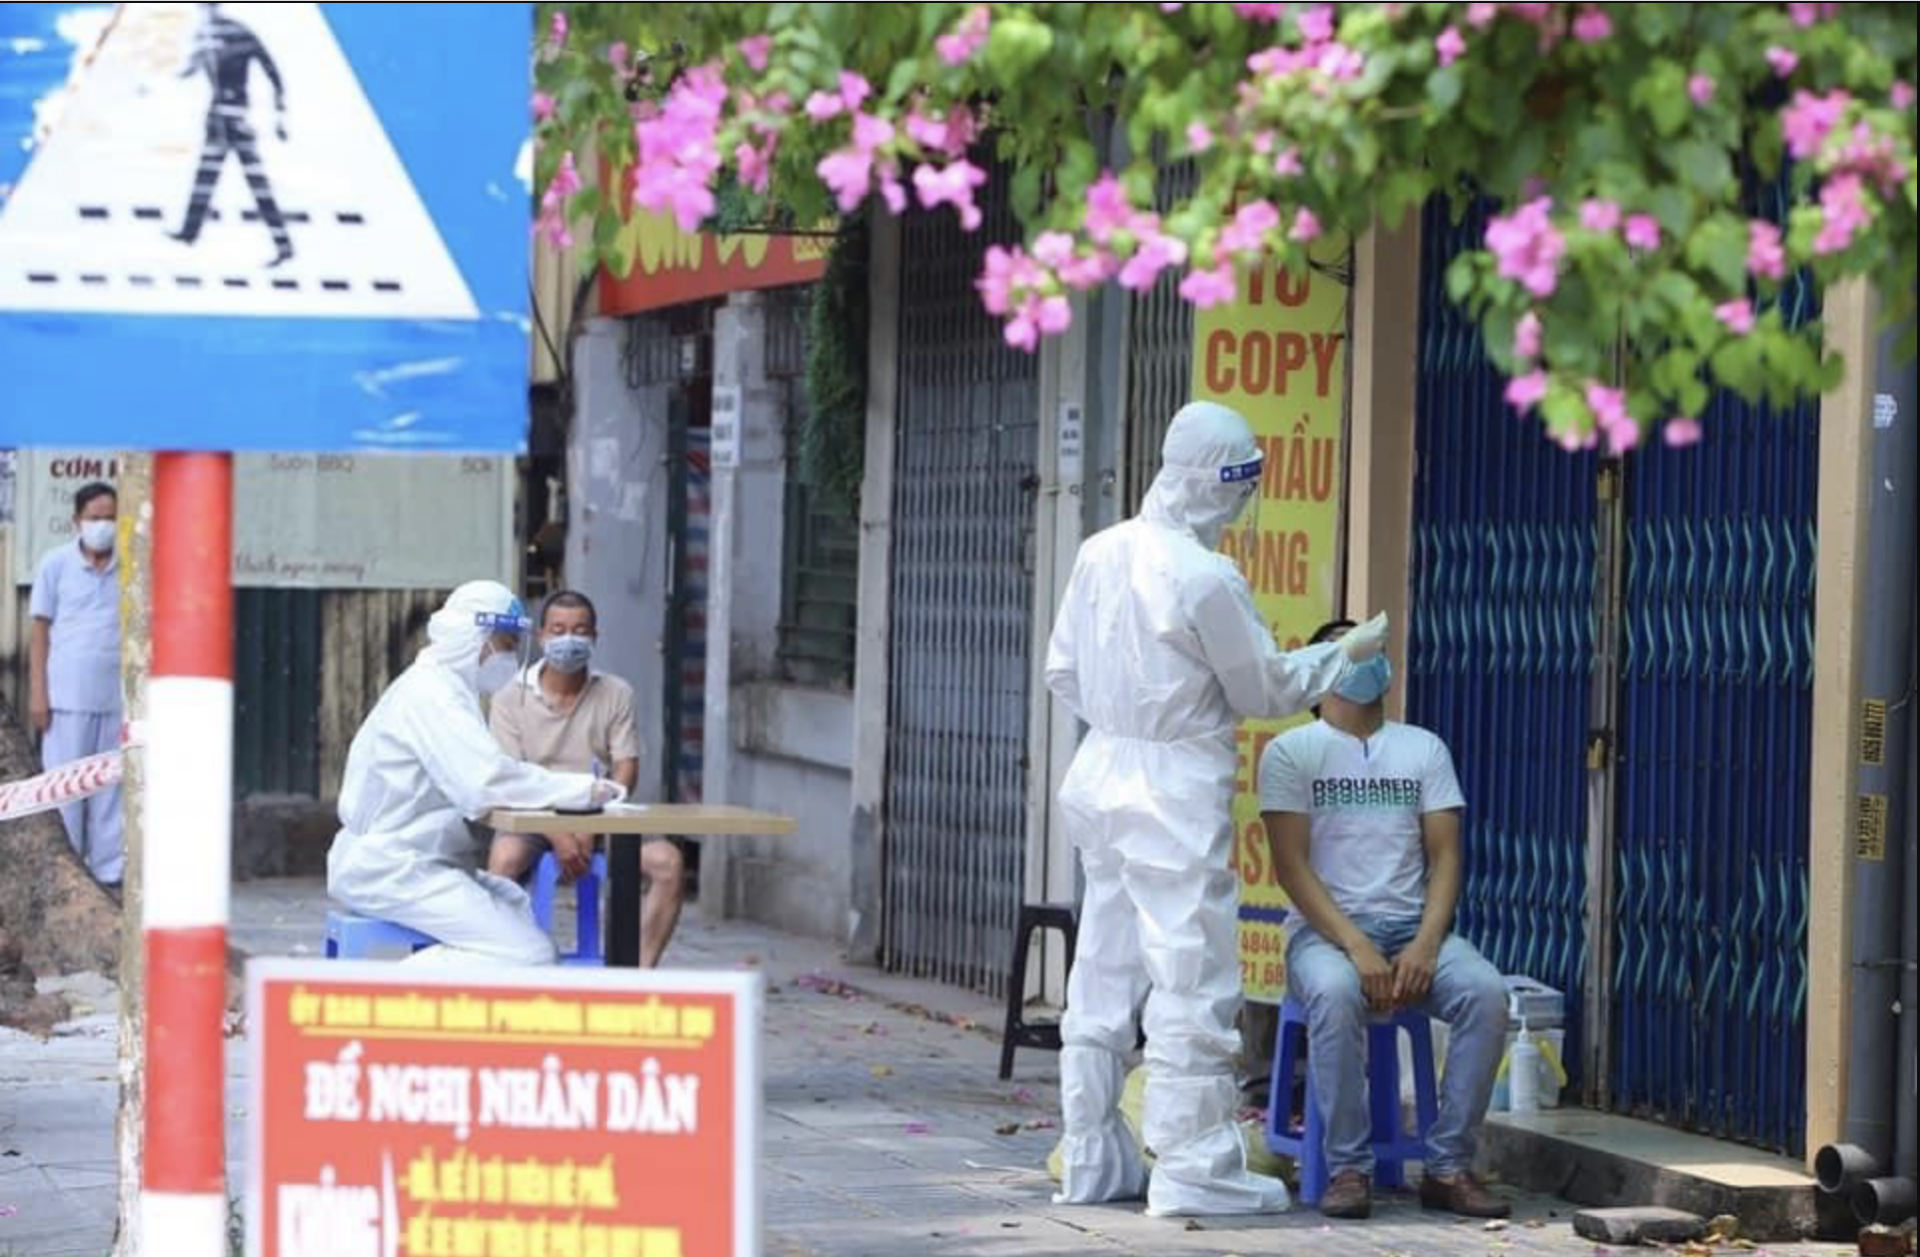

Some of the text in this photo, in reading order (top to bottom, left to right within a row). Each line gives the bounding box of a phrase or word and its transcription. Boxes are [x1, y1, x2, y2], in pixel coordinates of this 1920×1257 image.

[1205, 328, 1344, 398] COPY
[367, 1062, 473, 1140] NGHỊ
[478, 1053, 600, 1130] NHÂN
[606, 1056, 700, 1134] DÂN
